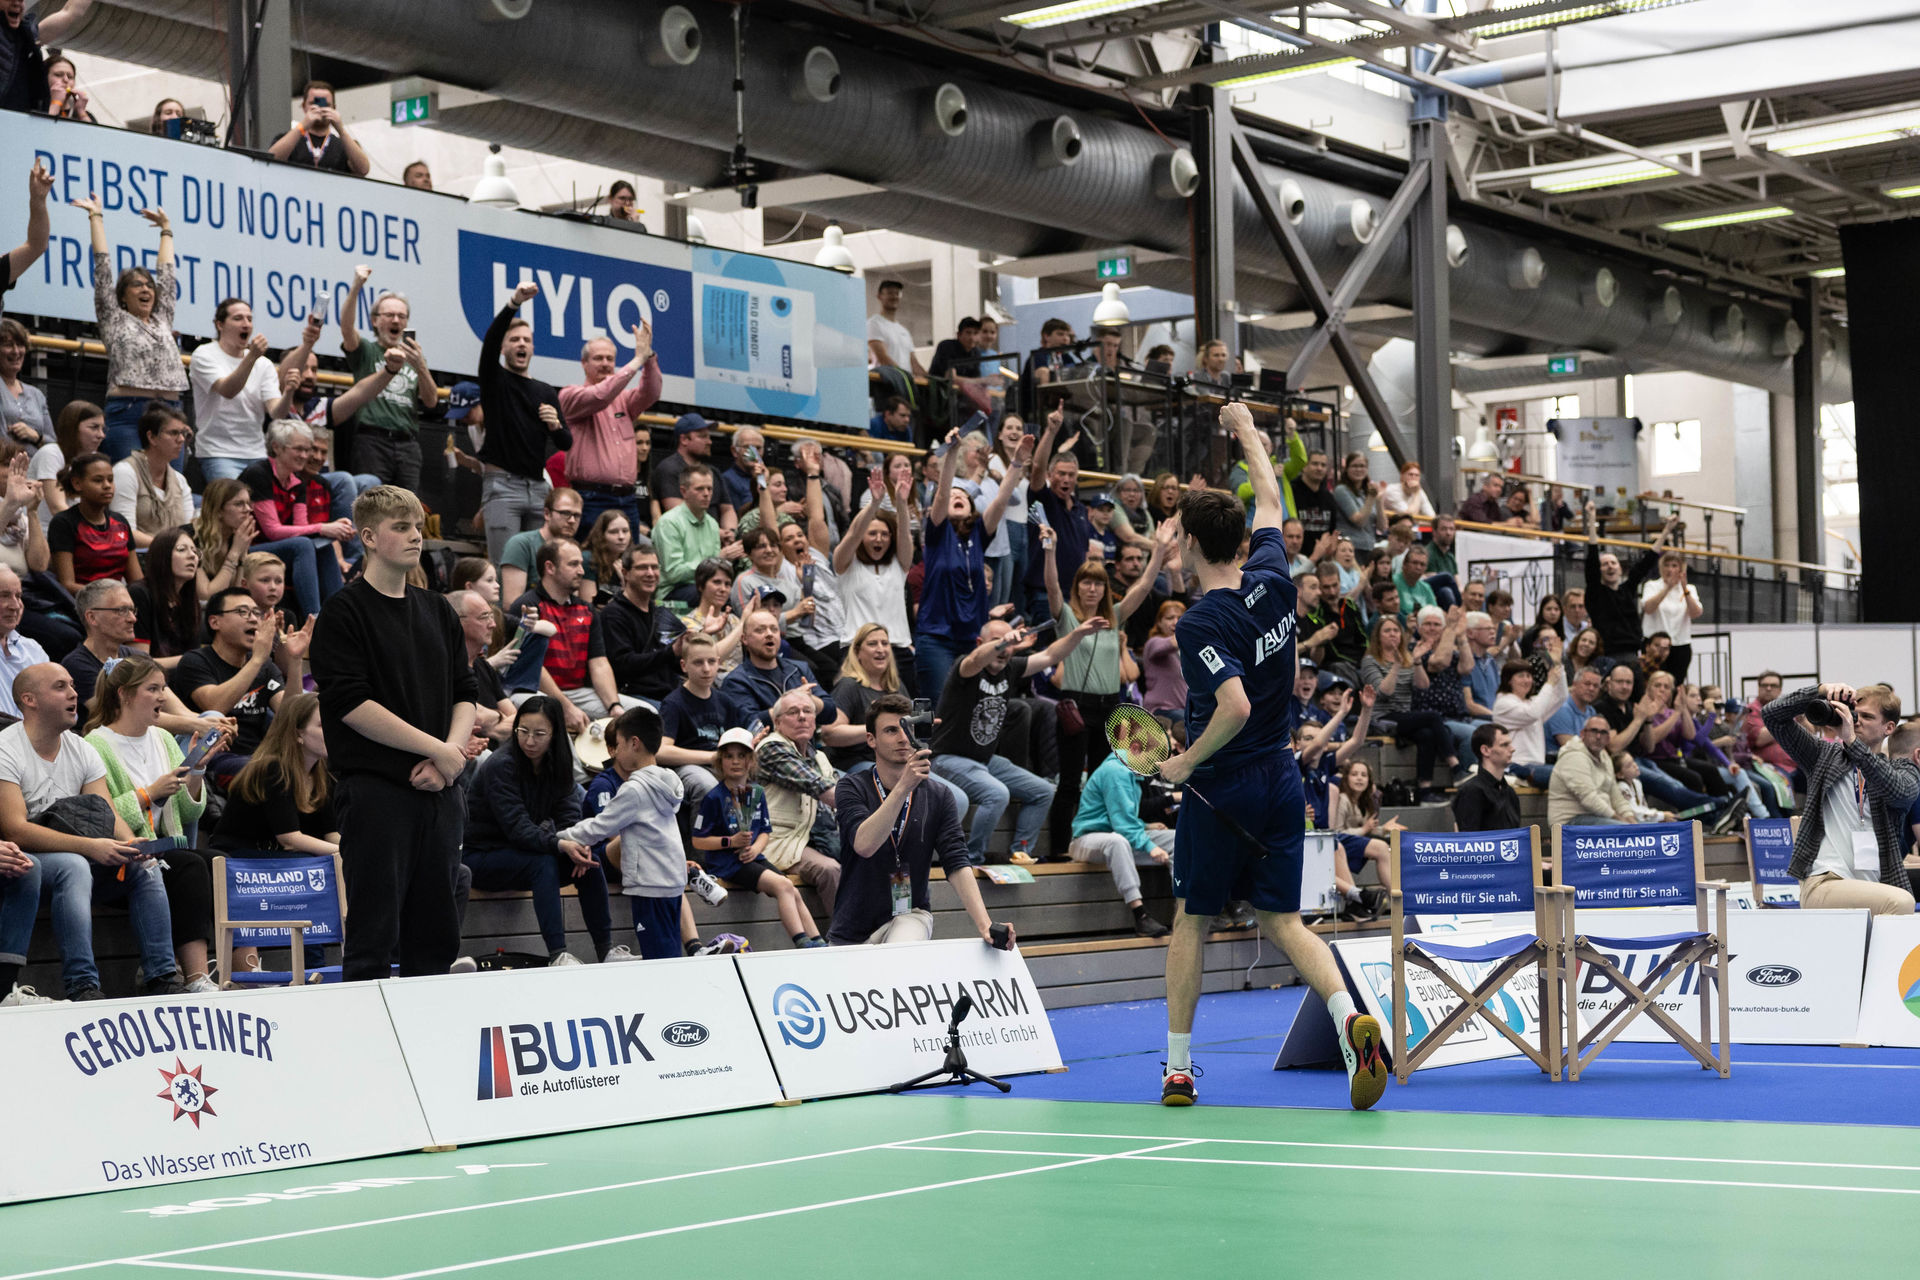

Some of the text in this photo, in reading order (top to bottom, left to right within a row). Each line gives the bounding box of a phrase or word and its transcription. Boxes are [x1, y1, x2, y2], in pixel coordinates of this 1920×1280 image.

[183, 175, 225, 229] DU
[238, 186, 325, 248] NOCH
[338, 206, 421, 265] ODER
[266, 270, 390, 331] SCHON
[1265, 609, 1296, 650] BUNK
[1414, 841, 1495, 853] SAARLAND
[1575, 835, 1656, 849] SAARLAND
[1415, 854, 1496, 863] Versicherungen
[1576, 849, 1657, 859] Versicherungen
[235, 871, 304, 884] SAARLAND
[235, 883, 307, 894] Versicherungen
[1576, 885, 1682, 901] Wir sind für Sie nah.
[1415, 890, 1521, 904] Wir sind für Sie nah.
[311, 922, 332, 934] nah.
[826, 977, 1030, 1034] URSAPHARM
[1577, 999, 1596, 1011] die
[1729, 1005, 1811, 1013] ww.autohaus-bunk.de
[508, 1013, 656, 1076] BUNK
[913, 1024, 1039, 1053] Arznemittel GmbH
[658, 1064, 733, 1081] www.autohaus-bunk.de
[520, 1073, 621, 1096] die Autoflüsterer
[101, 1138, 312, 1183] Das Wasser mit Stern
